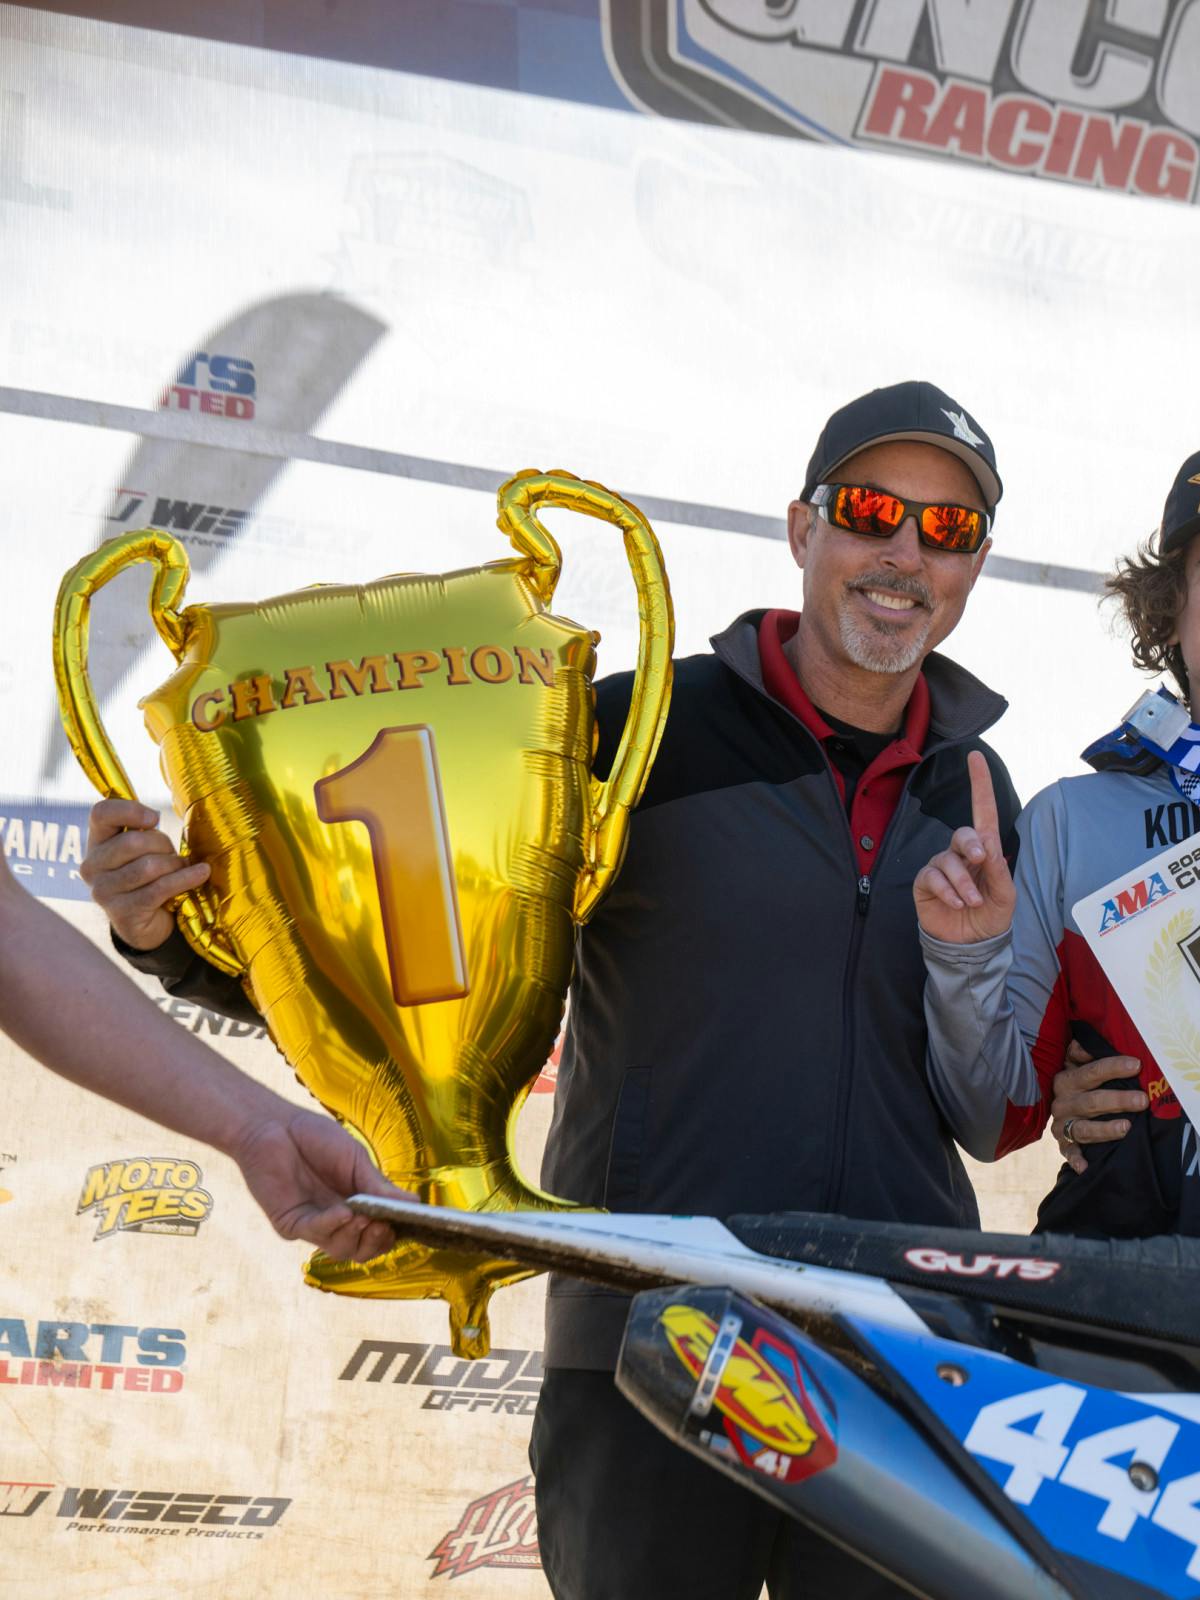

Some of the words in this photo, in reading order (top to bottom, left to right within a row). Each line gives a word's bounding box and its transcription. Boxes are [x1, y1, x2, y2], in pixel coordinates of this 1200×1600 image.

[864, 67, 1198, 203] RACING
[191, 643, 559, 733] CHAMPION
[314, 723, 470, 1008] 1
[1099, 871, 1175, 933] AMA
[80, 1158, 201, 1210] MOTO
[99, 1187, 212, 1234] TEES
[904, 1248, 1062, 1281] GUTS
[338, 1339, 545, 1393] MOOS
[65, 1521, 181, 1537] Performance
[185, 1526, 265, 1540] Products
